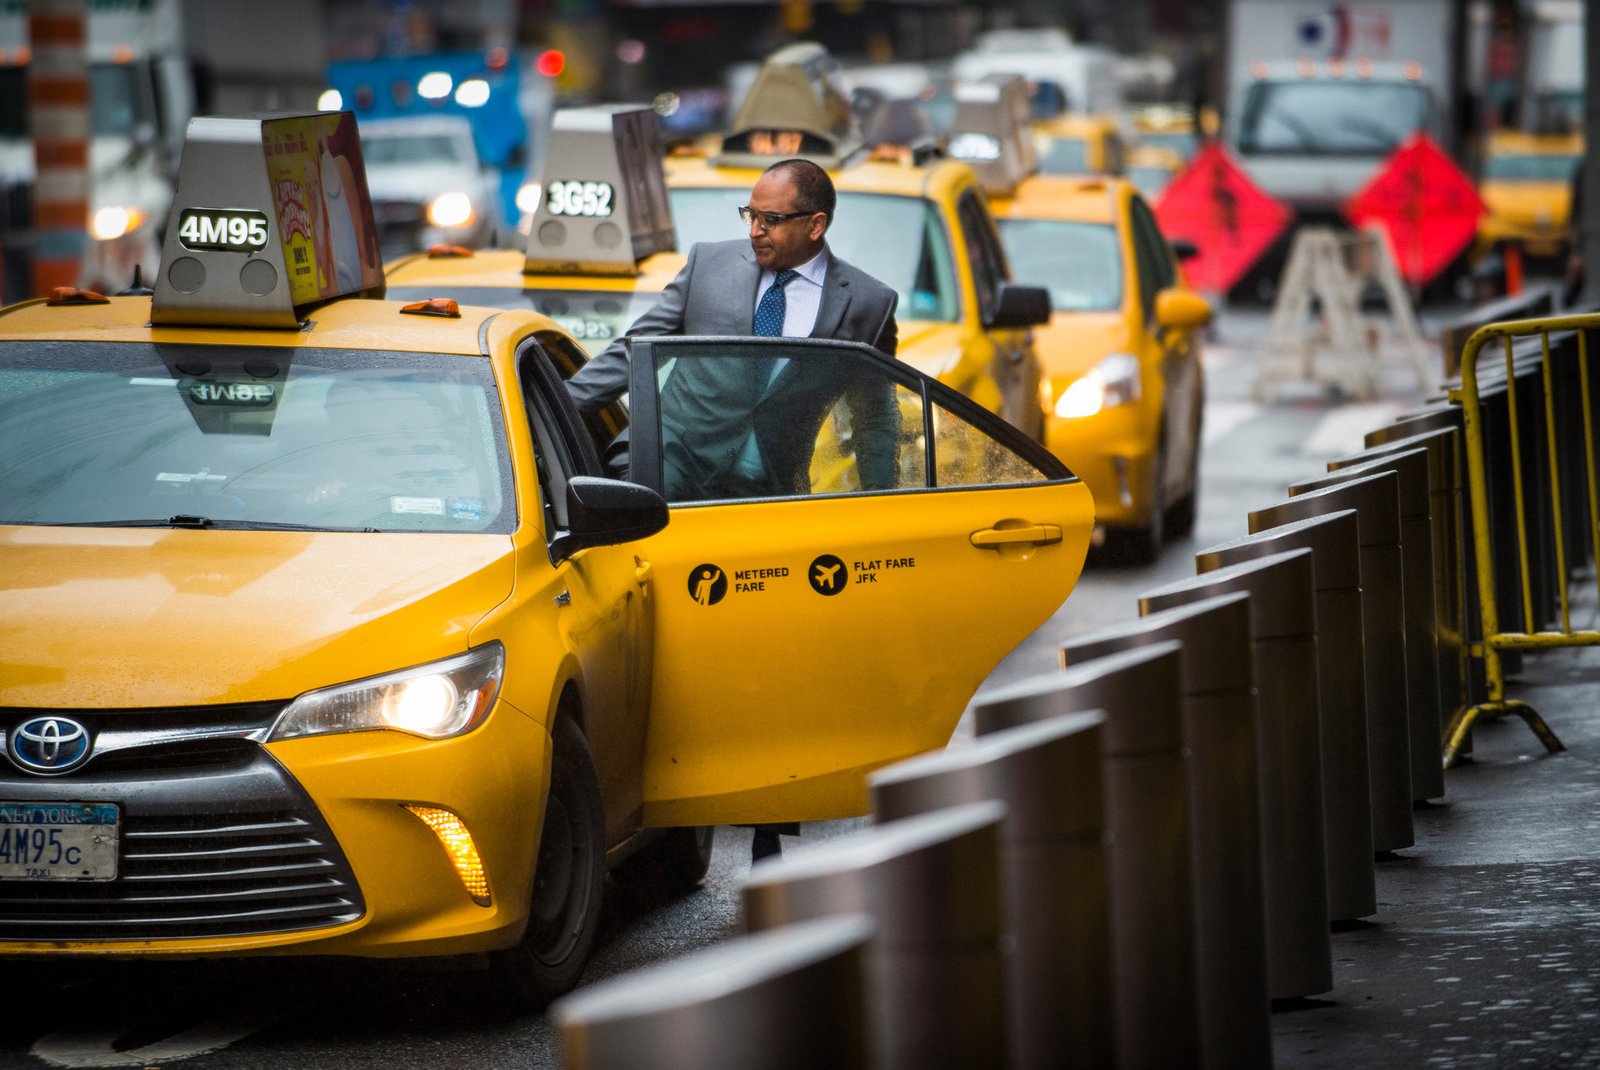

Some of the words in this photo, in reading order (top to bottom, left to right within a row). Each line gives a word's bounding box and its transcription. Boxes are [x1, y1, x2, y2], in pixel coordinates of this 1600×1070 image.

[548, 180, 612, 216] 3G52
[180, 216, 268, 246] 4M95
[854, 560, 882, 572] FLAT
[885, 557, 916, 569] FARE
[735, 567, 790, 580] METERED
[855, 573, 878, 584] JFK
[735, 581, 766, 593] FARE
[0, 808, 36, 823] NEW
[41, 808, 82, 824] YORK
[26, 868, 52, 878] TAXI
